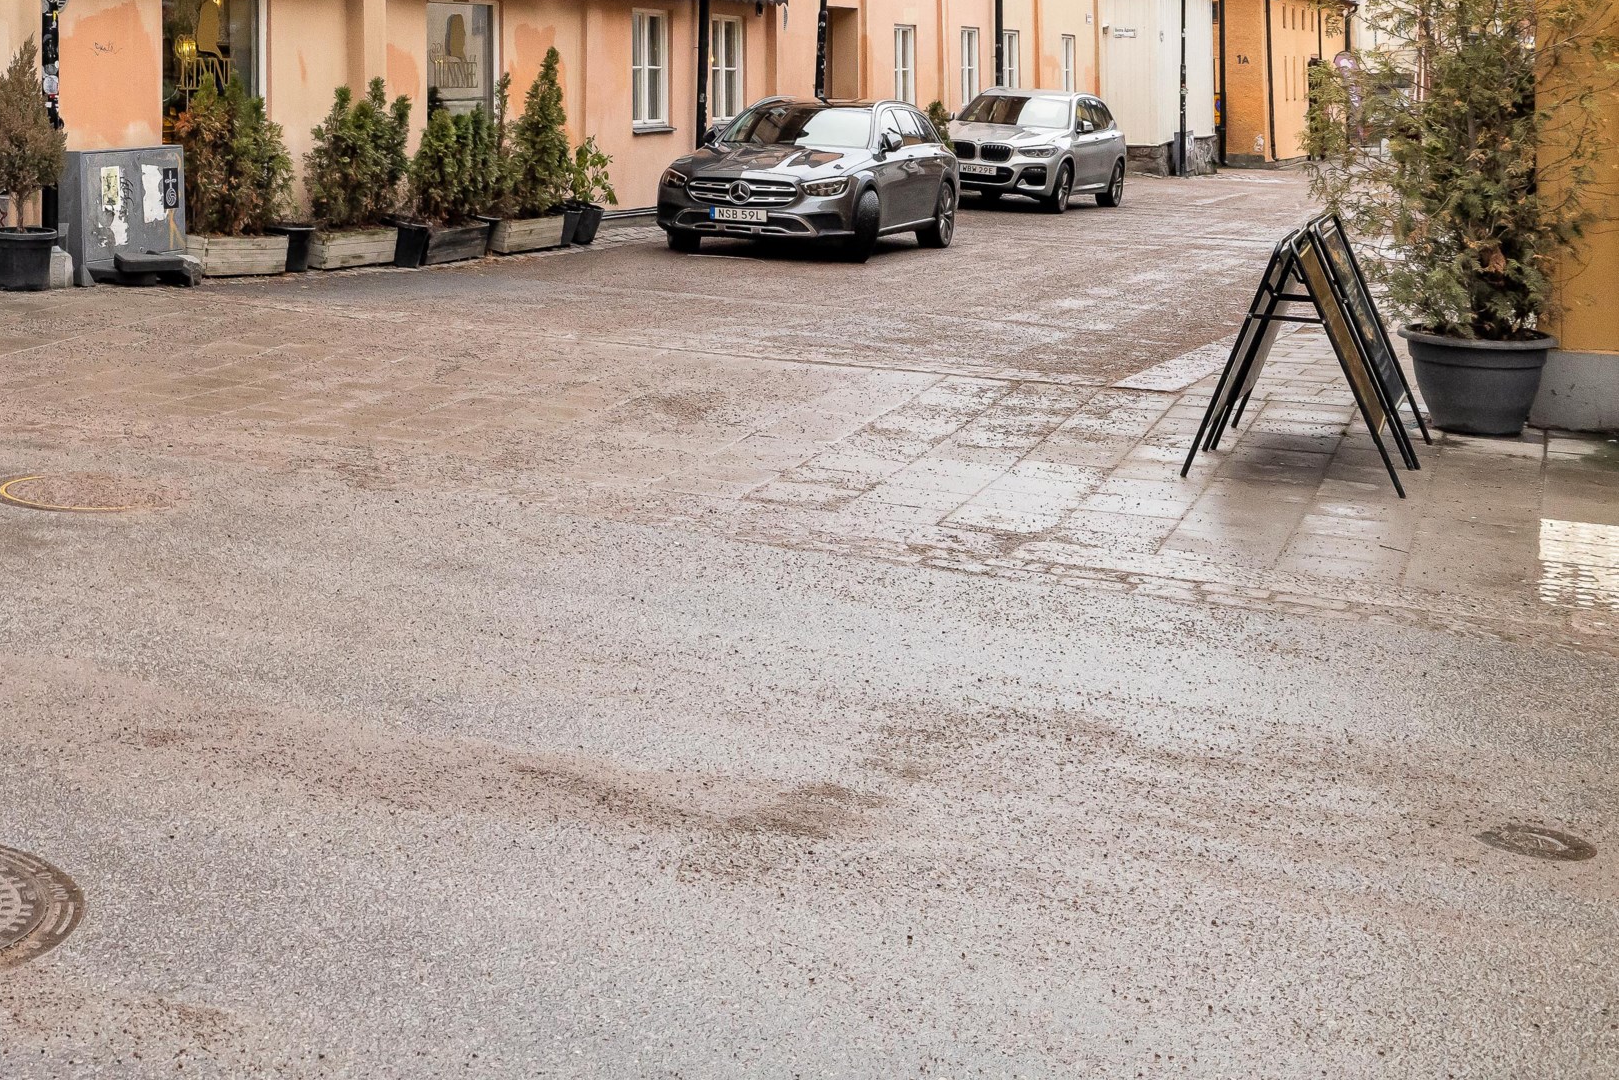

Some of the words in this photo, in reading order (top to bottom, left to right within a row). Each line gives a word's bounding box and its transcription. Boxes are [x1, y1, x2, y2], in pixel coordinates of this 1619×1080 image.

[1236, 54, 1250, 65] 1A
[718, 208, 738, 219] NSB
[741, 210, 762, 221] 59L
